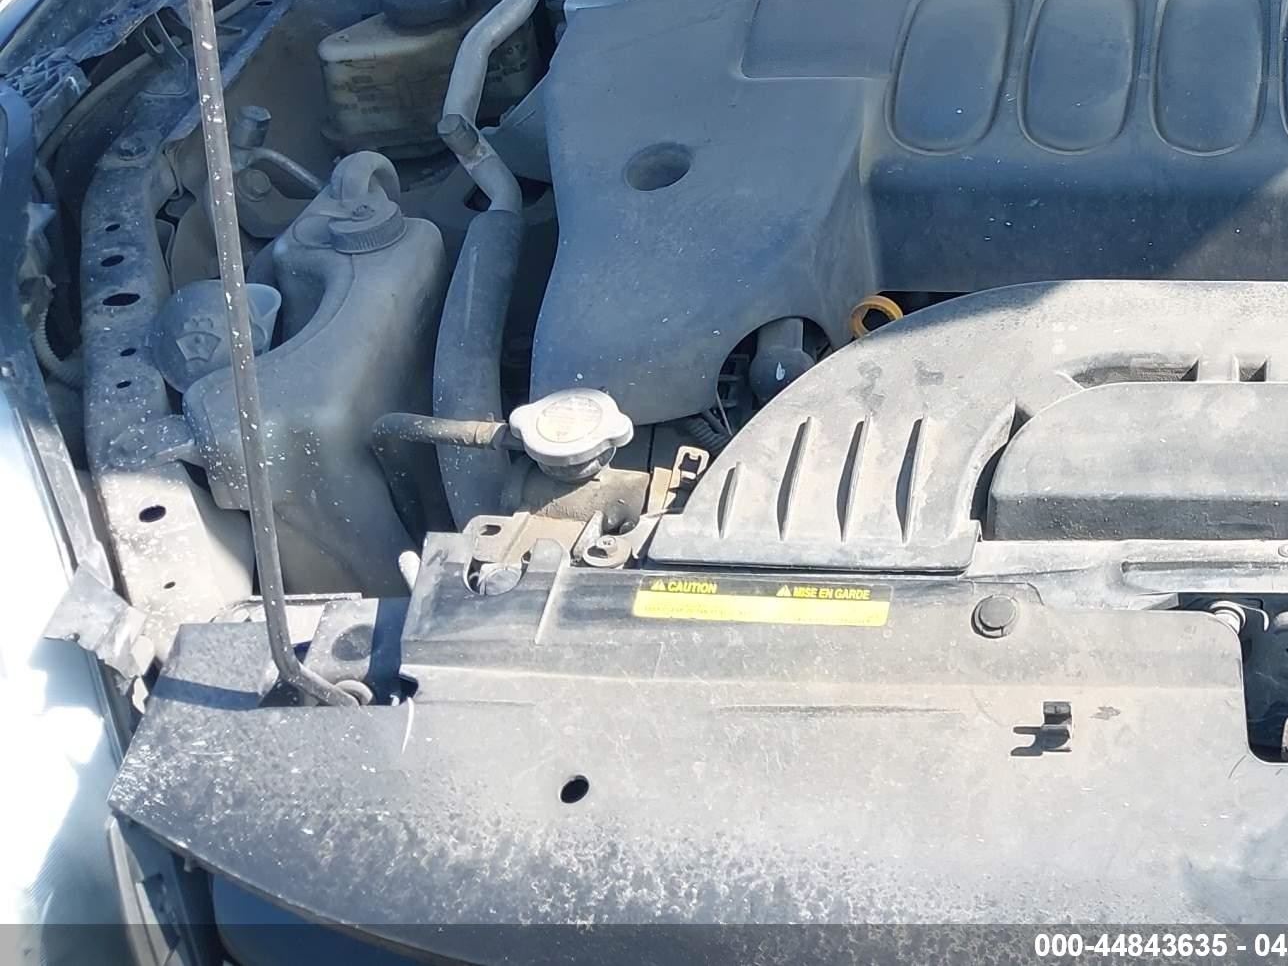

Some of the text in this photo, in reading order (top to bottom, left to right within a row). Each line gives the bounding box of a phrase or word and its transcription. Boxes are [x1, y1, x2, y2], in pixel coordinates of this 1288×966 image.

[667, 580, 718, 594] CAUTION
[792, 586, 872, 601] MISE EN GARDE
